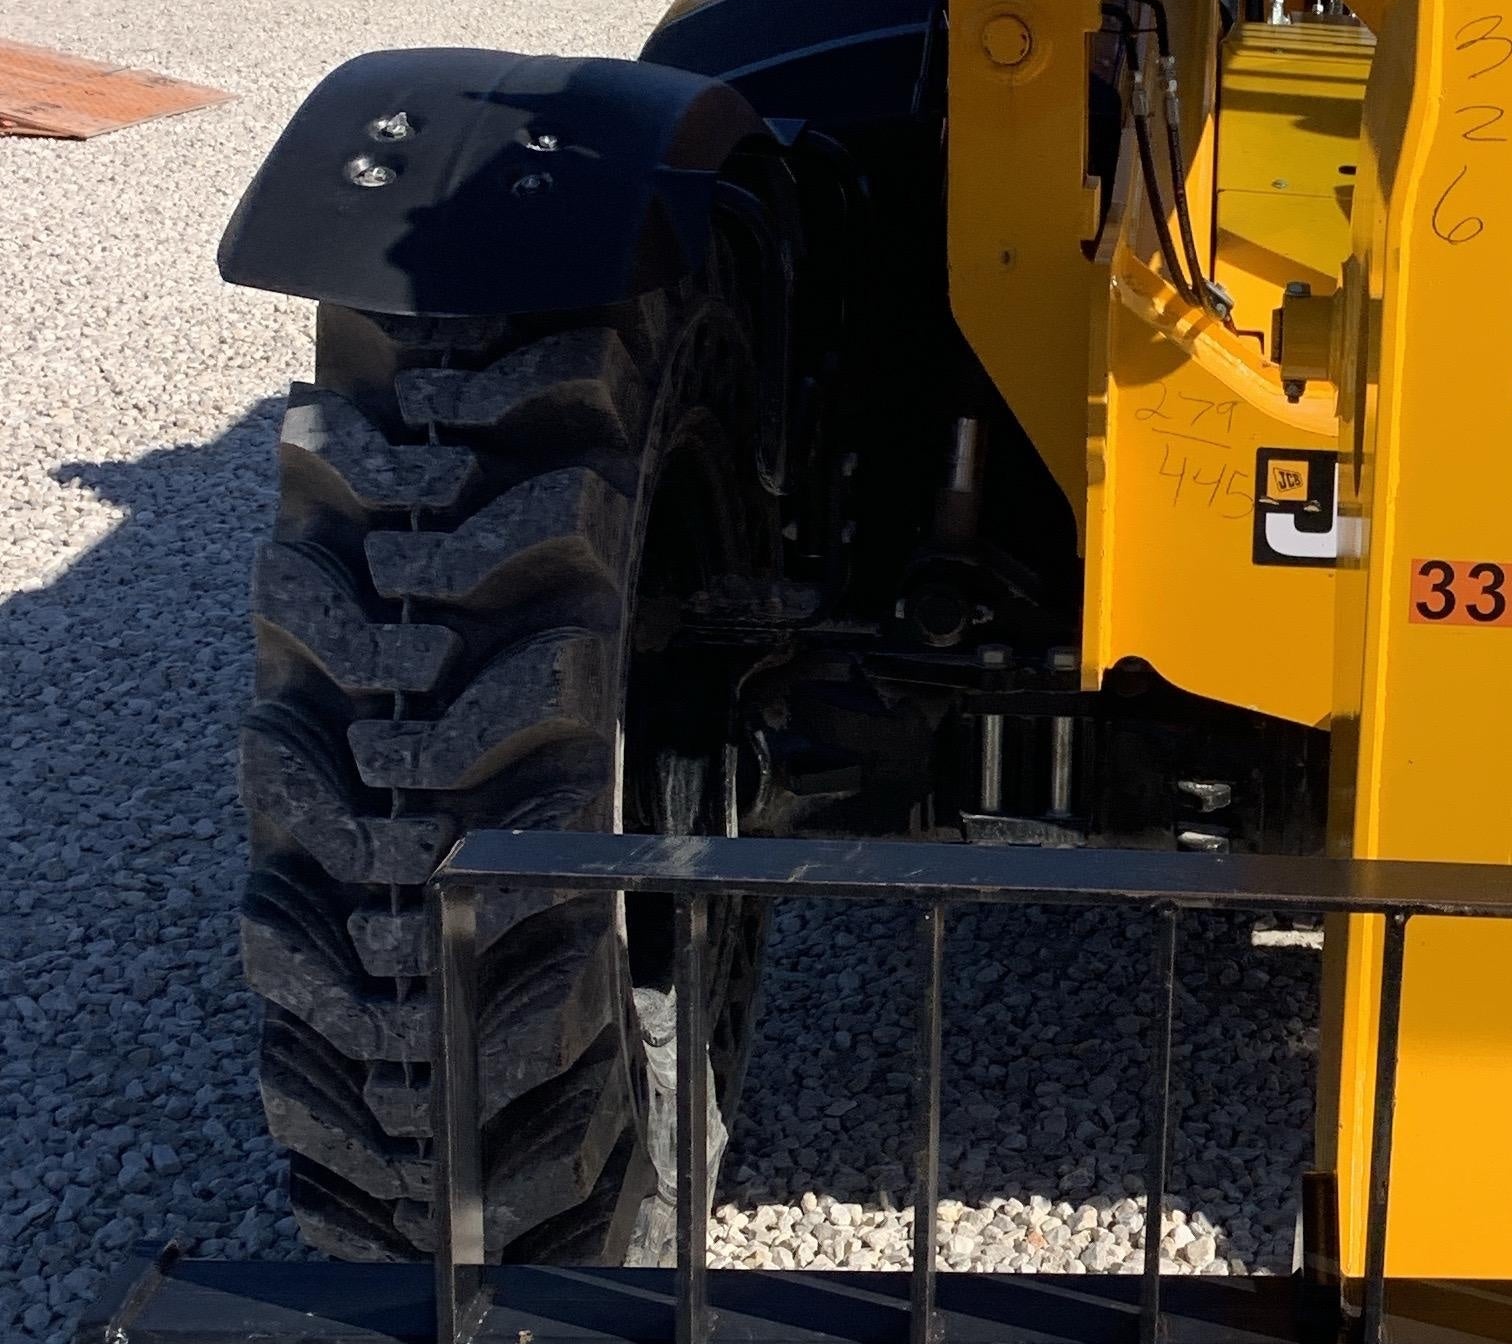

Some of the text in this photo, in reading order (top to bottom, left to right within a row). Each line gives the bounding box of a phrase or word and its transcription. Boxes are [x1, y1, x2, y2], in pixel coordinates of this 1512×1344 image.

[1134, 381, 1240, 434] 279
[1157, 442, 1255, 520] 445
[1276, 469, 1303, 491] JCB
